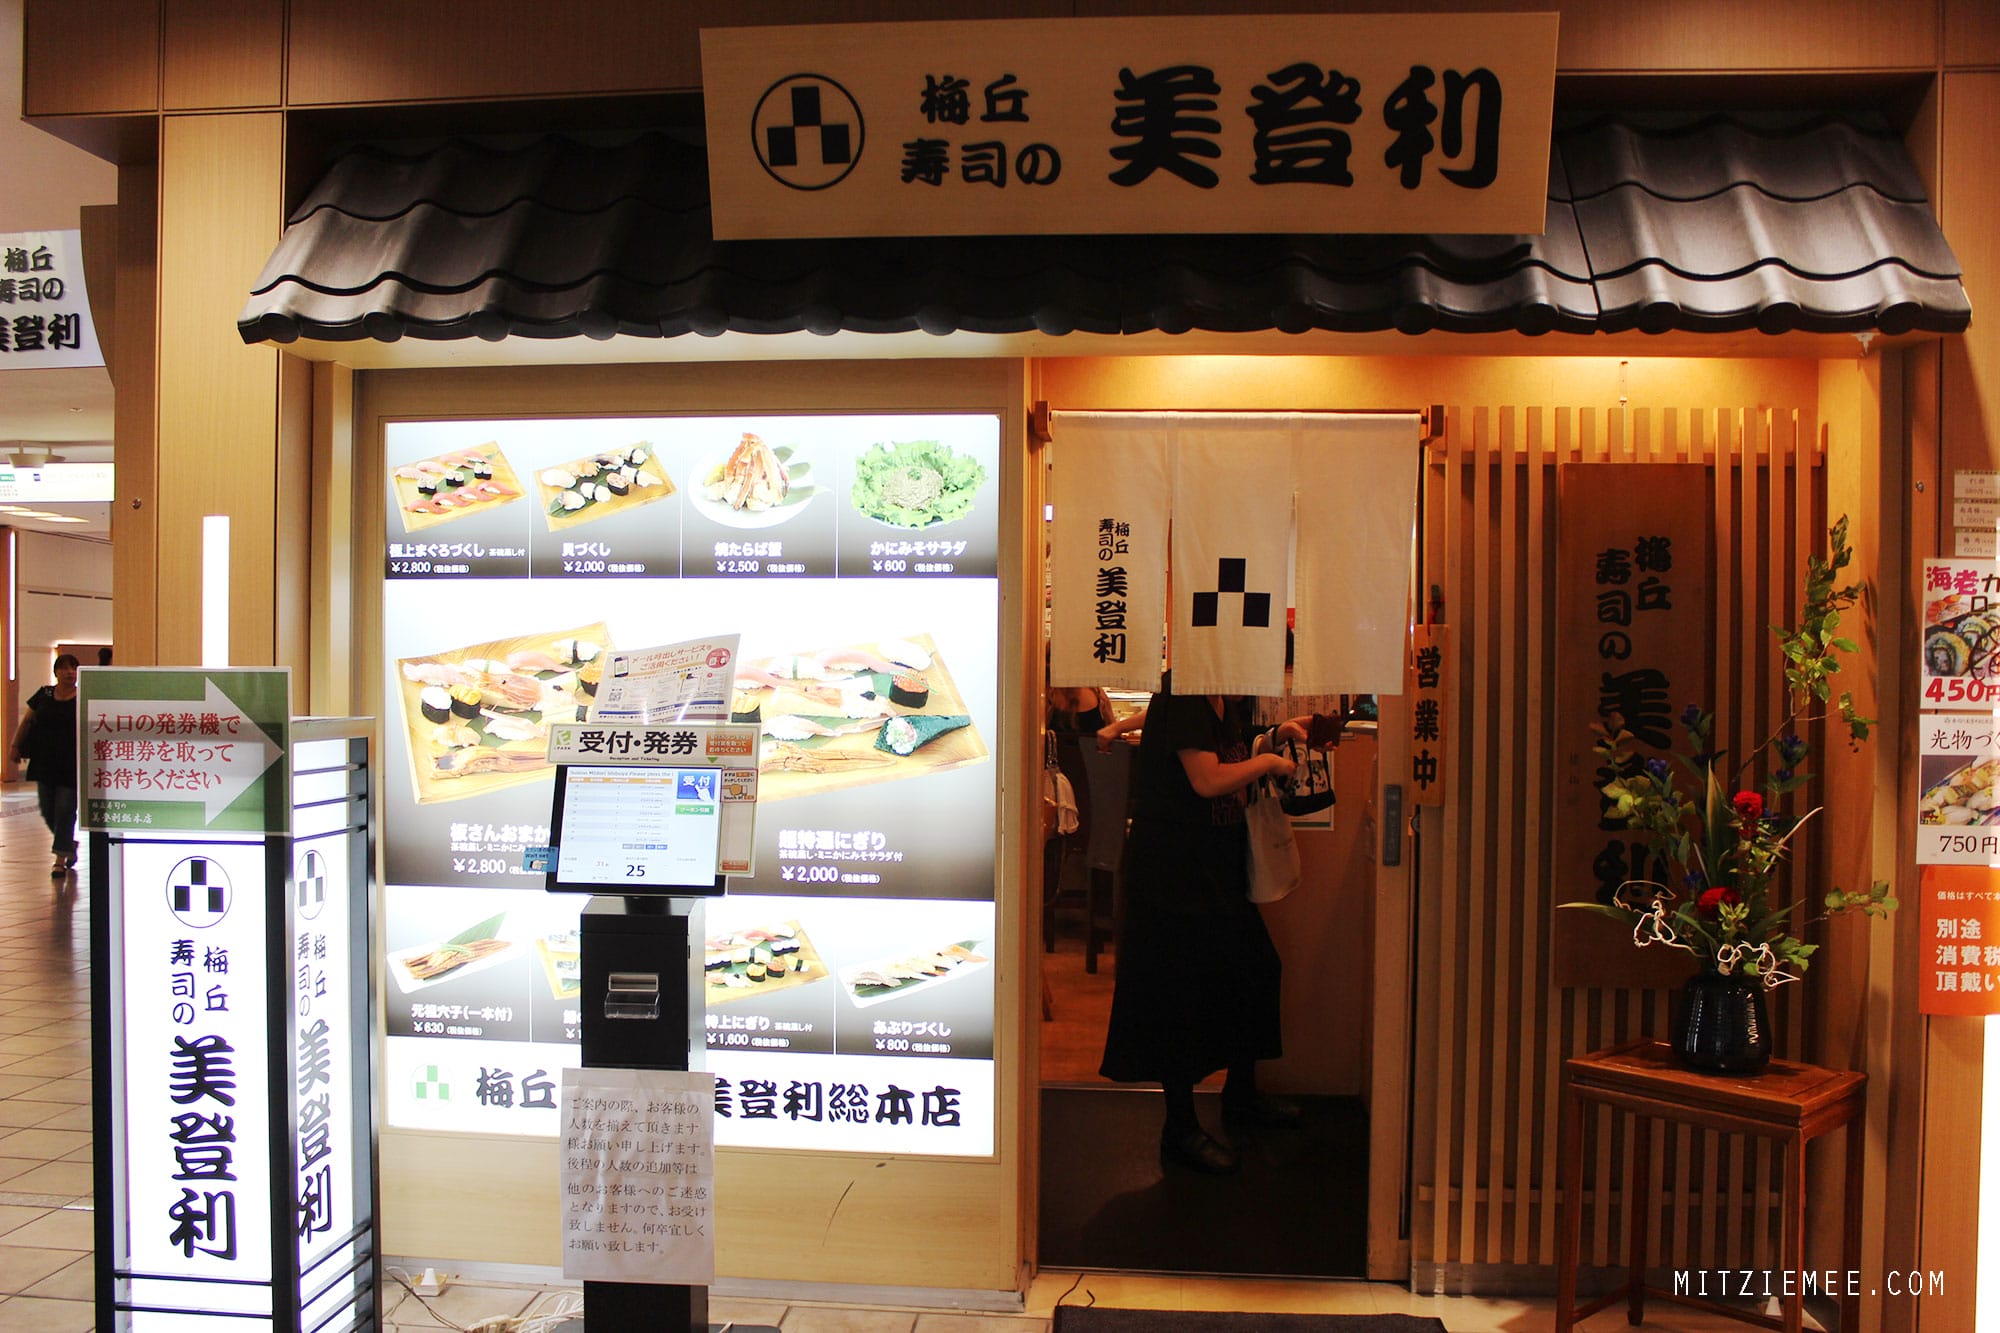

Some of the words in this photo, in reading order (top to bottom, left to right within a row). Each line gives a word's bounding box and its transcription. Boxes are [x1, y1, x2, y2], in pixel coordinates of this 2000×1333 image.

[920, 73, 1030, 125] 梅丘
[1108, 63, 1502, 189] 美登利
[900, 139, 1062, 187] 寿司の
[4, 246, 54, 272] 梅丘
[870, 540, 967, 556] かにみそサラダ
[1099, 518, 1114, 561] 寿司の
[1115, 522, 1130, 554] 梅丘
[1635, 536, 1672, 610] 梅丘
[1093, 567, 1128, 664] 美登利
[1596, 549, 1632, 659] 寿司の
[95, 712, 241, 736] 入口の発券機で
[1413, 645, 1441, 791] 営業中
[93, 740, 234, 763] 整理券を取って
[578, 730, 698, 755] 受付・発券
[93, 768, 222, 791] お待ちください
[1939, 835, 1999, 854] 750円
[626, 865, 646, 877] 25
[1936, 918, 1982, 939] 別途
[204, 946, 229, 1012] 梅丘
[297, 932, 311, 1017] 寿司の
[314, 933, 326, 999] 梅丘
[171, 939, 195, 1025] 寿司の
[873, 1020, 951, 1036] あぶりづくし
[476, 1066, 557, 1109] 梅丘
[299, 1019, 332, 1244] 美登利
[569, 1118, 699, 1134] 人数を揃えて頂きます
[169, 1035, 237, 1261] 美登利
[567, 1137, 705, 1157] 様お願い申し上げます。
[567, 1157, 698, 1175] 後程の人数の追加等は
[567, 1183, 708, 1200] 他のお客様へのご迷惑
[569, 1201, 705, 1217] となりますので、お受け
[569, 1220, 705, 1236] 致しません。何卒宜しく
[569, 1238, 665, 1254] お願い致します。
